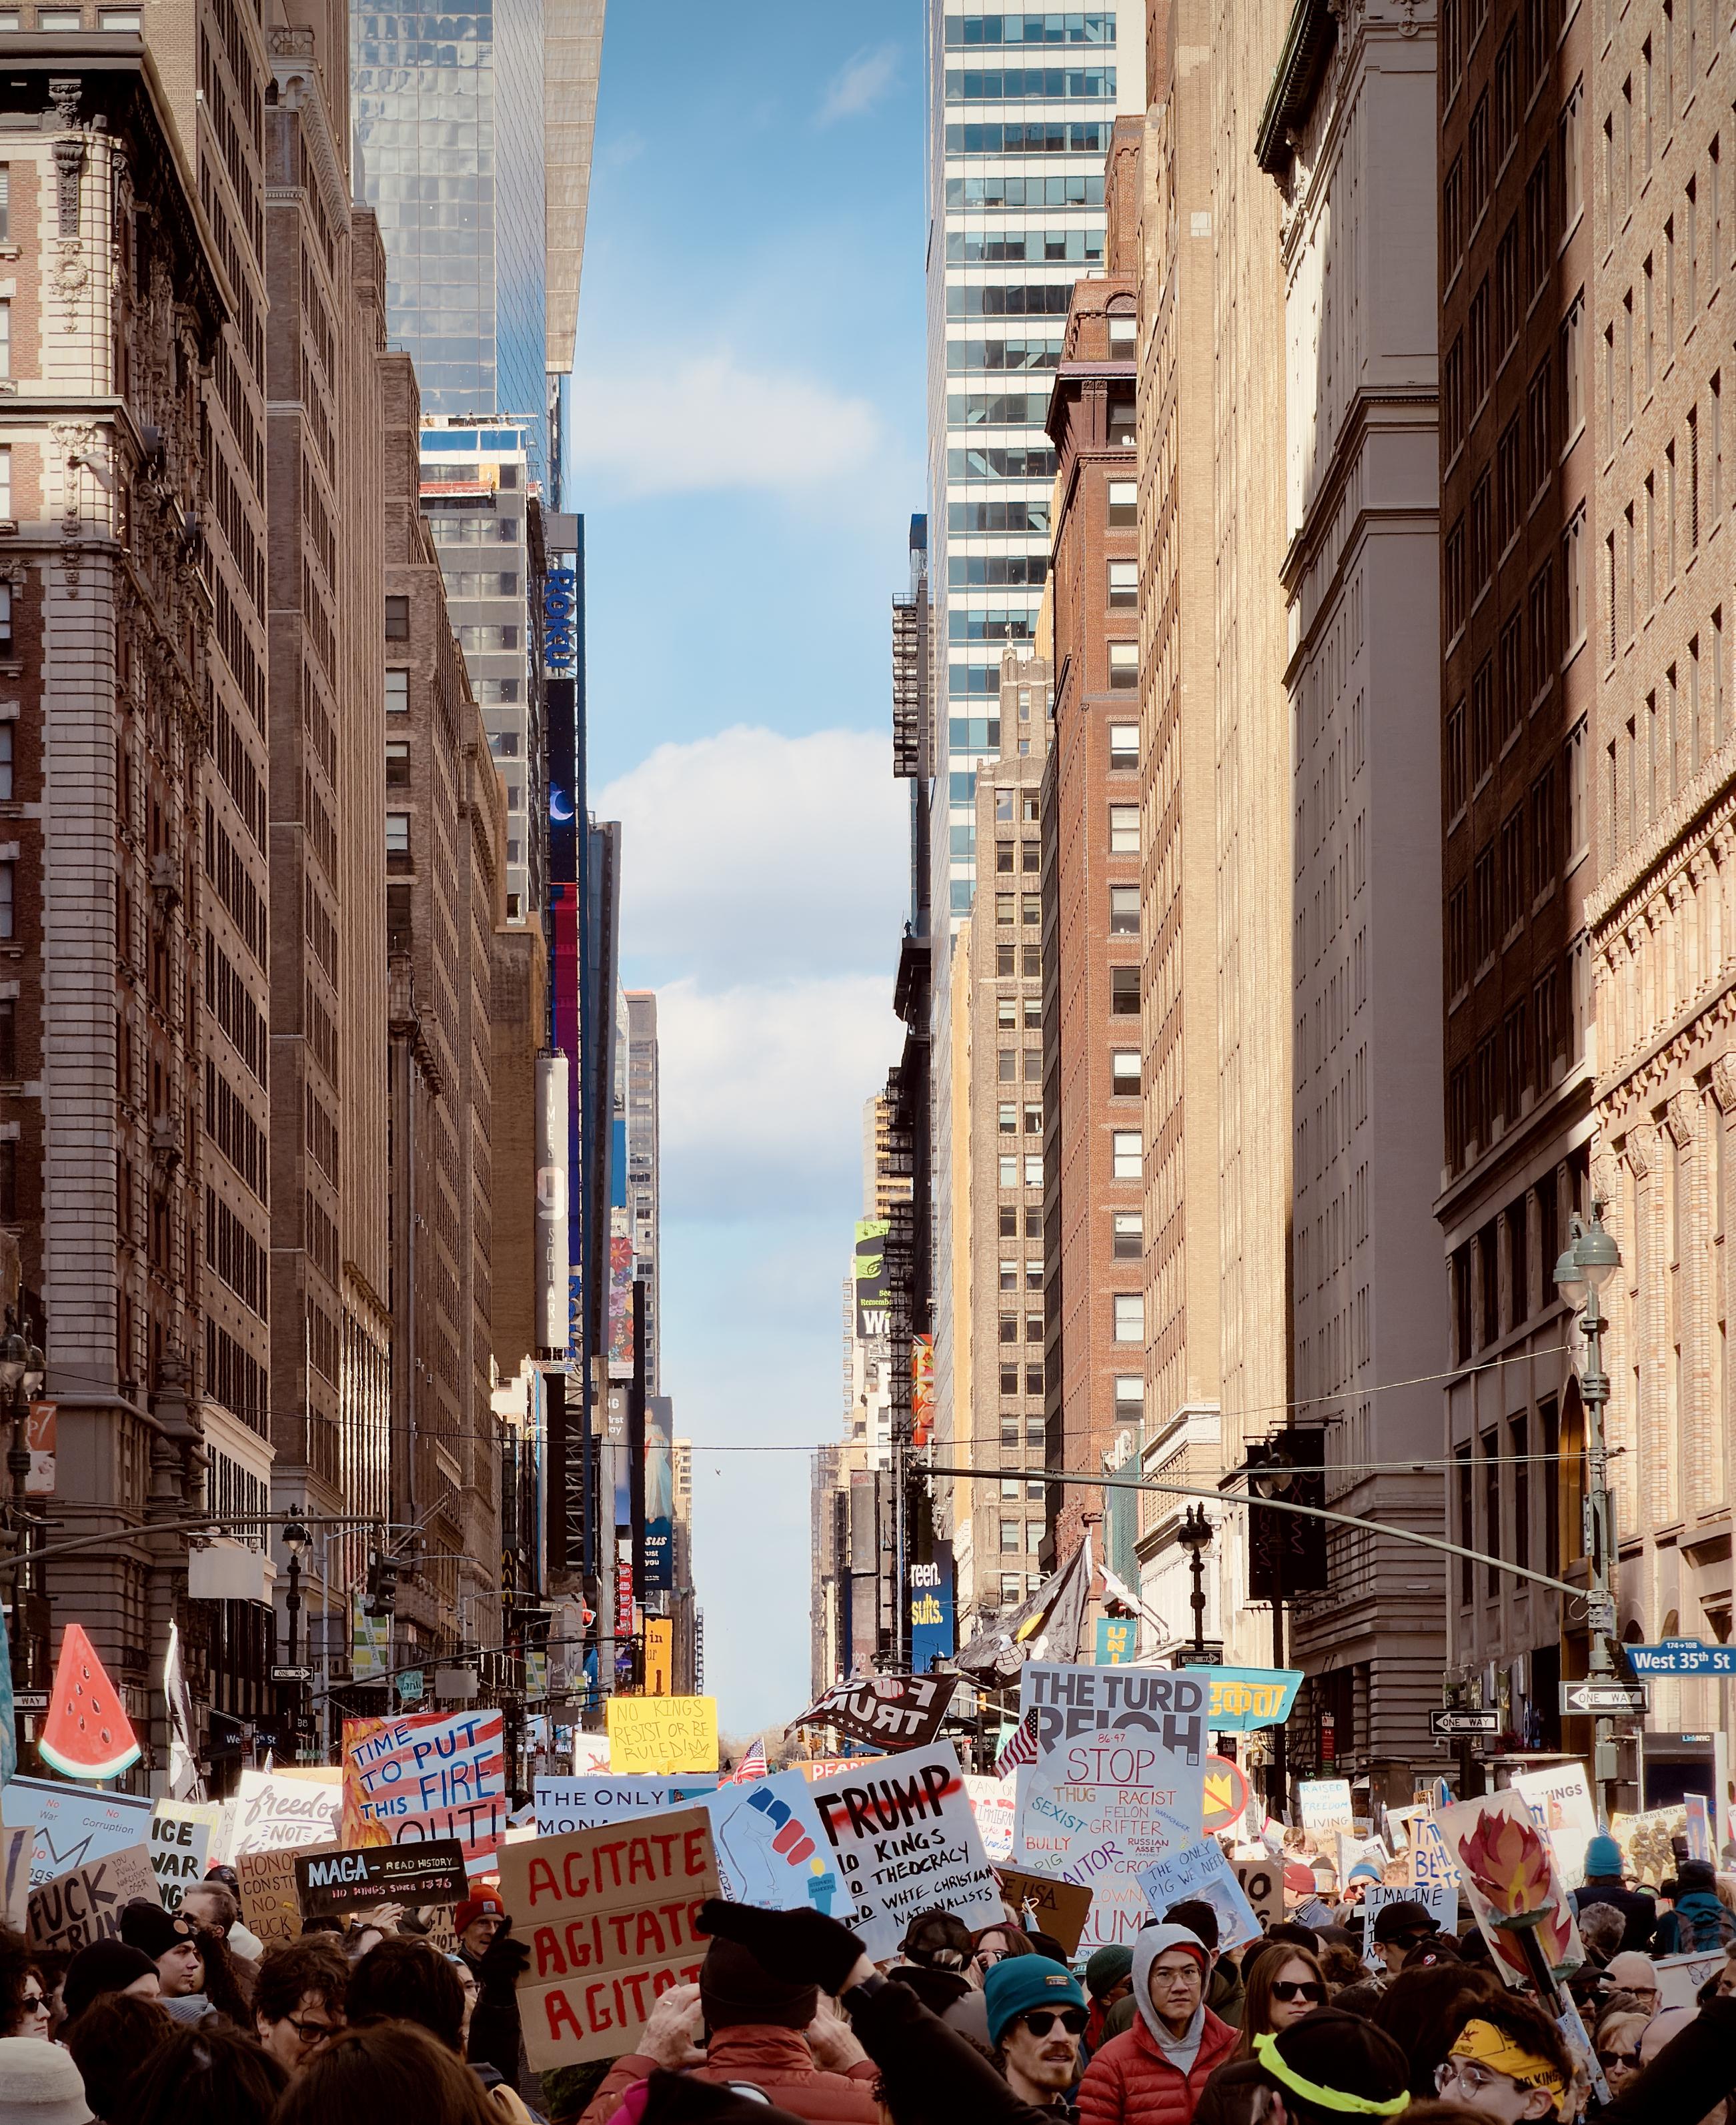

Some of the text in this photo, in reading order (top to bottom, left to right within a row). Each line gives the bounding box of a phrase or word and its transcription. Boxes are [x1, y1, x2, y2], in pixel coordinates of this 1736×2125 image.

[547, 1067, 556, 1159] TIMES
[547, 1227, 556, 1339] SQUARE
[1634, 1651, 1731, 1669] West 35th St
[21, 1697, 41, 1705] WAY
[1030, 1671, 1203, 1713] THE TURD
[1579, 1693, 1636, 1703] ONE WAY
[618, 1699, 704, 1721] NO KINGS
[1443, 1718, 1489, 1727] ONE WAY
[226, 1735, 276, 1744] We St
[614, 1721, 710, 1747] RESIST OR BE
[351, 1723, 413, 1766] TIME
[625, 1739, 688, 1761] RULED!
[359, 1718, 481, 1792] TO PUT
[1067, 1748, 1156, 1784] STOP
[360, 1749, 496, 1819] THIS FIRE
[968, 1780, 1016, 1796] CAN ON
[1303, 1784, 1343, 1793] RAISED
[46, 1799, 60, 1808] No
[1053, 1787, 1096, 1803] THUG
[1119, 1790, 1176, 1806] RACIST
[39, 1811, 59, 1821] War
[105, 1809, 120, 1819] No
[814, 1765, 950, 1847] TRUMP
[976, 1805, 1015, 1825] IMMIGRAN
[1032, 1797, 1088, 1833] SEXIST
[1104, 1806, 1149, 1818] FELON
[1303, 1802, 1349, 1812] FREEDOM
[1621, 1816, 1639, 1824] THE
[1640, 1811, 1661, 1822] BRAVE
[1663, 1807, 1678, 1816] MEN
[82, 1818, 134, 1835] Corruption
[396, 1804, 497, 1848] OUT!
[538, 1820, 608, 1834] MON
[1090, 1820, 1164, 1836] GRIFTER
[1154, 1808, 1190, 1833] WARMONGER
[1305, 1816, 1349, 1830] LIVING
[151, 1818, 194, 1846] ICE
[269, 1824, 312, 1842] NOT
[874, 1828, 946, 1863] KINGS
[1026, 1836, 1070, 1850] BULLY
[1128, 1838, 1169, 1847] RUSSIAN
[308, 1855, 369, 1887] MAGA
[385, 1860, 415, 1870] READ
[417, 1858, 453, 1868] HISTORY
[528, 1828, 707, 1907] AGITATE
[870, 1841, 969, 1885] THEOCRACY
[1034, 1853, 1063, 1870] PIG
[1148, 1842, 1210, 1881] THE ONLY
[243, 1875, 295, 1895] CONSTI
[809, 1879, 832, 1887] STEPHEN
[934, 1864, 992, 1894] CHRISTIAN
[1149, 1878, 1174, 1900] PIG
[1178, 1867, 1196, 1886] WE
[1200, 1852, 1225, 1875] NEED
[332, 1878, 452, 1898] NO KINGS SINCE 1776
[1020, 1881, 1056, 1908] USA
[28, 1864, 118, 1942] FUCK
[253, 1896, 276, 1914] NO
[249, 1916, 292, 1936] FUCK
[534, 1898, 710, 1978] AGITATE
